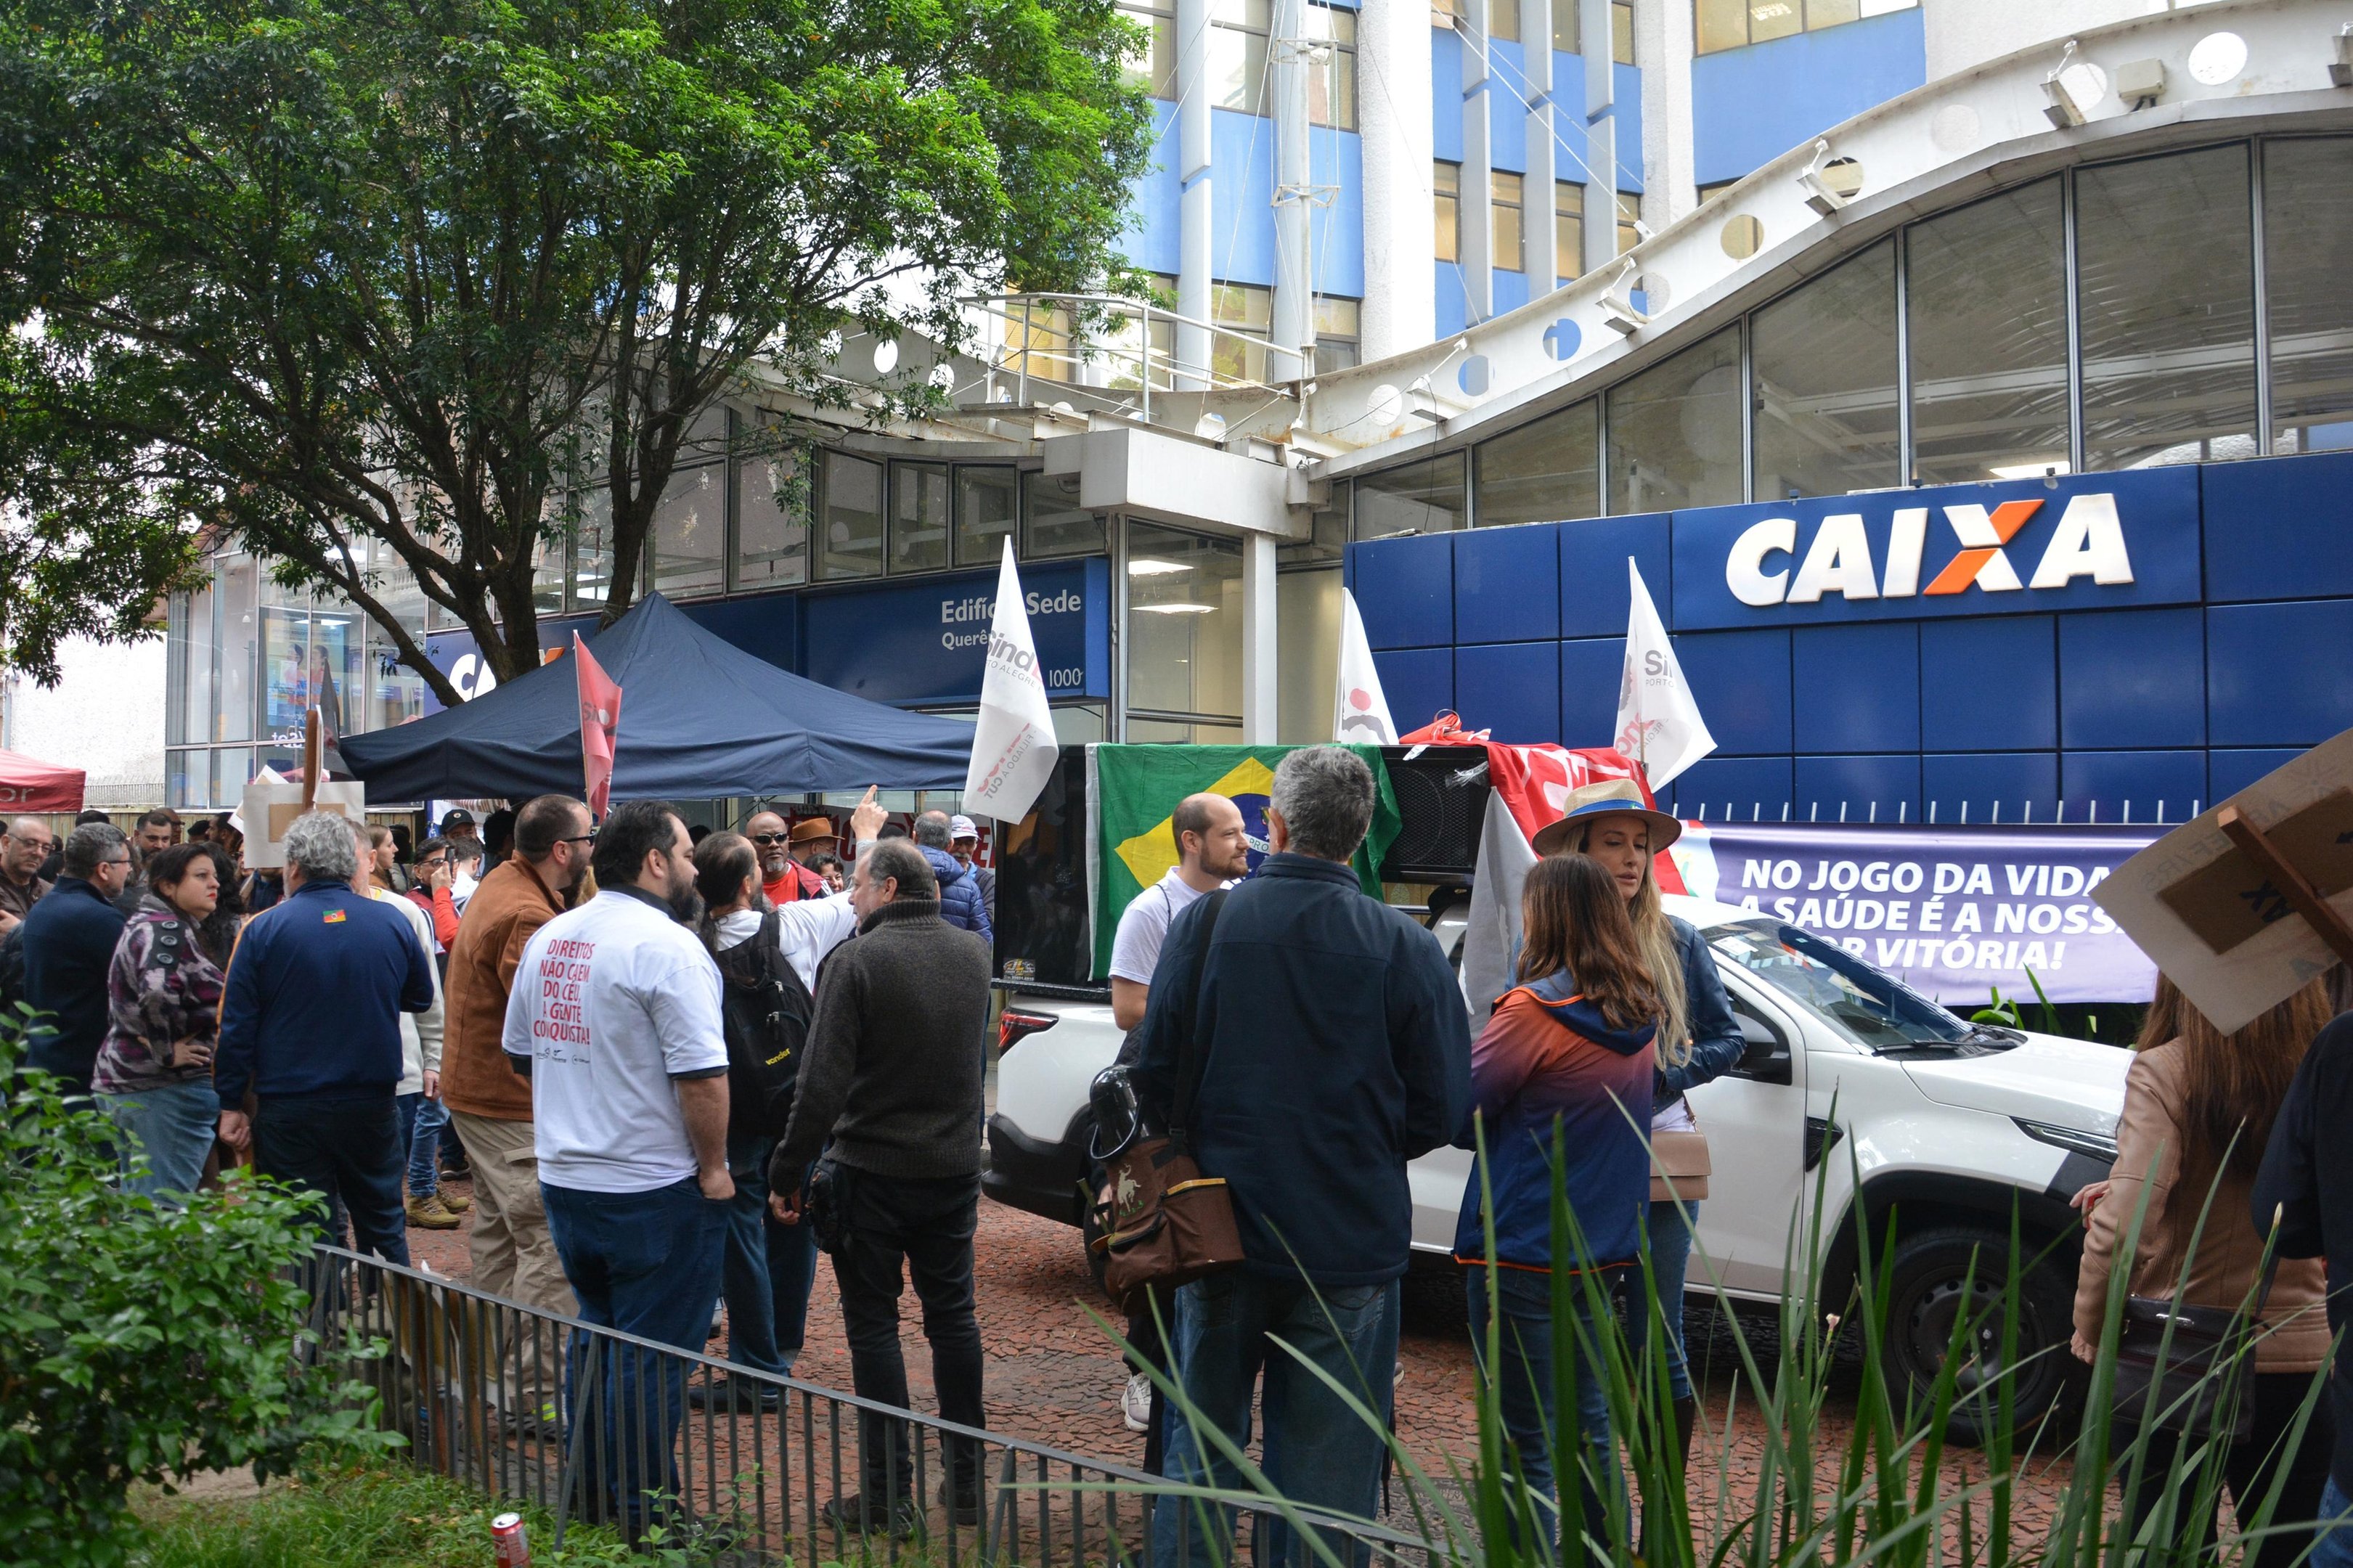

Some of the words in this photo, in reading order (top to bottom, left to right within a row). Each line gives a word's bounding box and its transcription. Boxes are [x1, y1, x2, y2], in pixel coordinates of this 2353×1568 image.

[1726, 493, 2134, 607] CAIXA
[942, 597, 996, 624] Edifíc
[1026, 589, 1081, 616] Sede
[942, 629, 992, 650] Querê
[1049, 667, 1082, 687] 1000
[1742, 859, 1802, 890] NO
[1808, 860, 1924, 894] JOGO
[1933, 862, 1994, 895] DA
[2005, 865, 2111, 897] VIDA
[1774, 892, 1911, 931] SAÚDE
[1918, 894, 1945, 932] É
[1951, 902, 1982, 933] A
[1993, 903, 2126, 934] NOSS
[547, 939, 595, 960] DIREITOS
[1875, 933, 2067, 971] VITÓRIA!
[539, 956, 565, 979] NÃO
[567, 963, 591, 983] CAEM
[544, 980, 559, 999] DO
[542, 1000, 547, 1019] A
[550, 1002, 582, 1024] GENTE
[534, 1019, 590, 1045] CONQUISTA!
